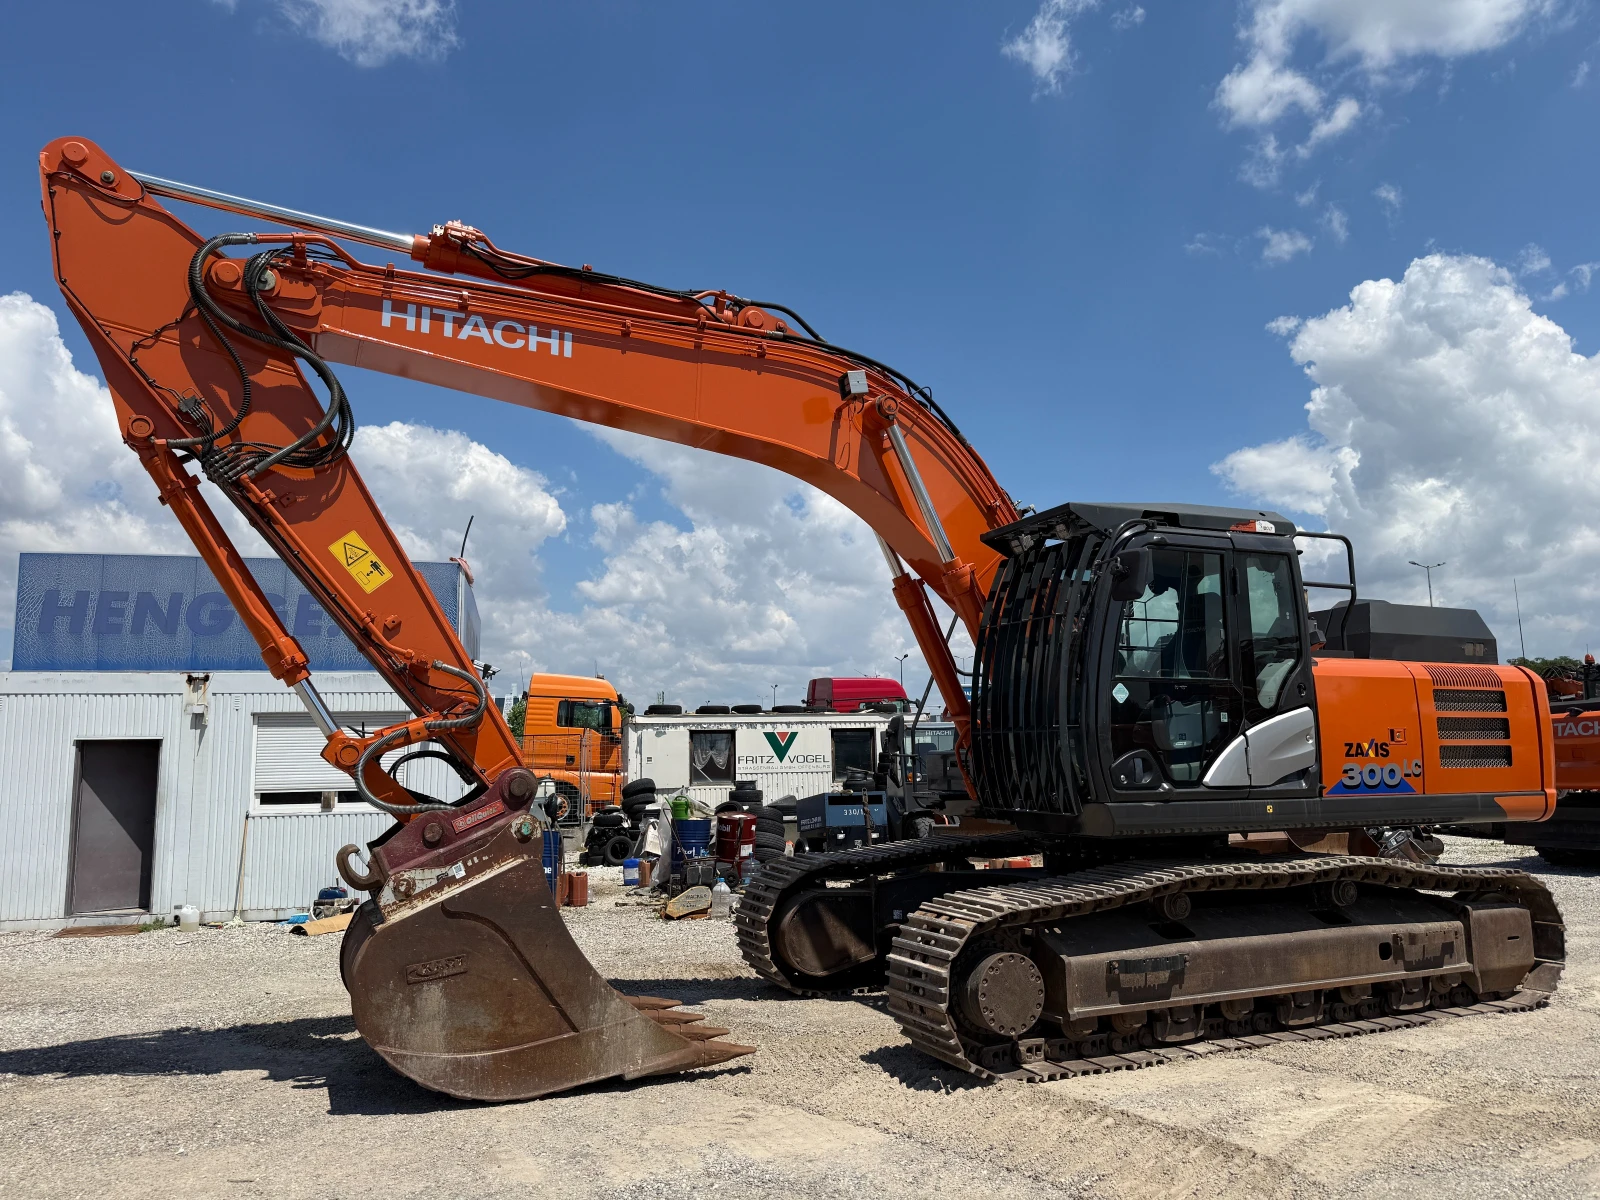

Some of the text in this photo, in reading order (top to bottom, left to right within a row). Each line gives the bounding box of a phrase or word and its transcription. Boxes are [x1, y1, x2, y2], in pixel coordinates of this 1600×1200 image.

[381, 300, 573, 358] HITACHI
[1344, 738, 1390, 758] ZAXIS
[737, 755, 830, 764] FRITZ VOGEL
